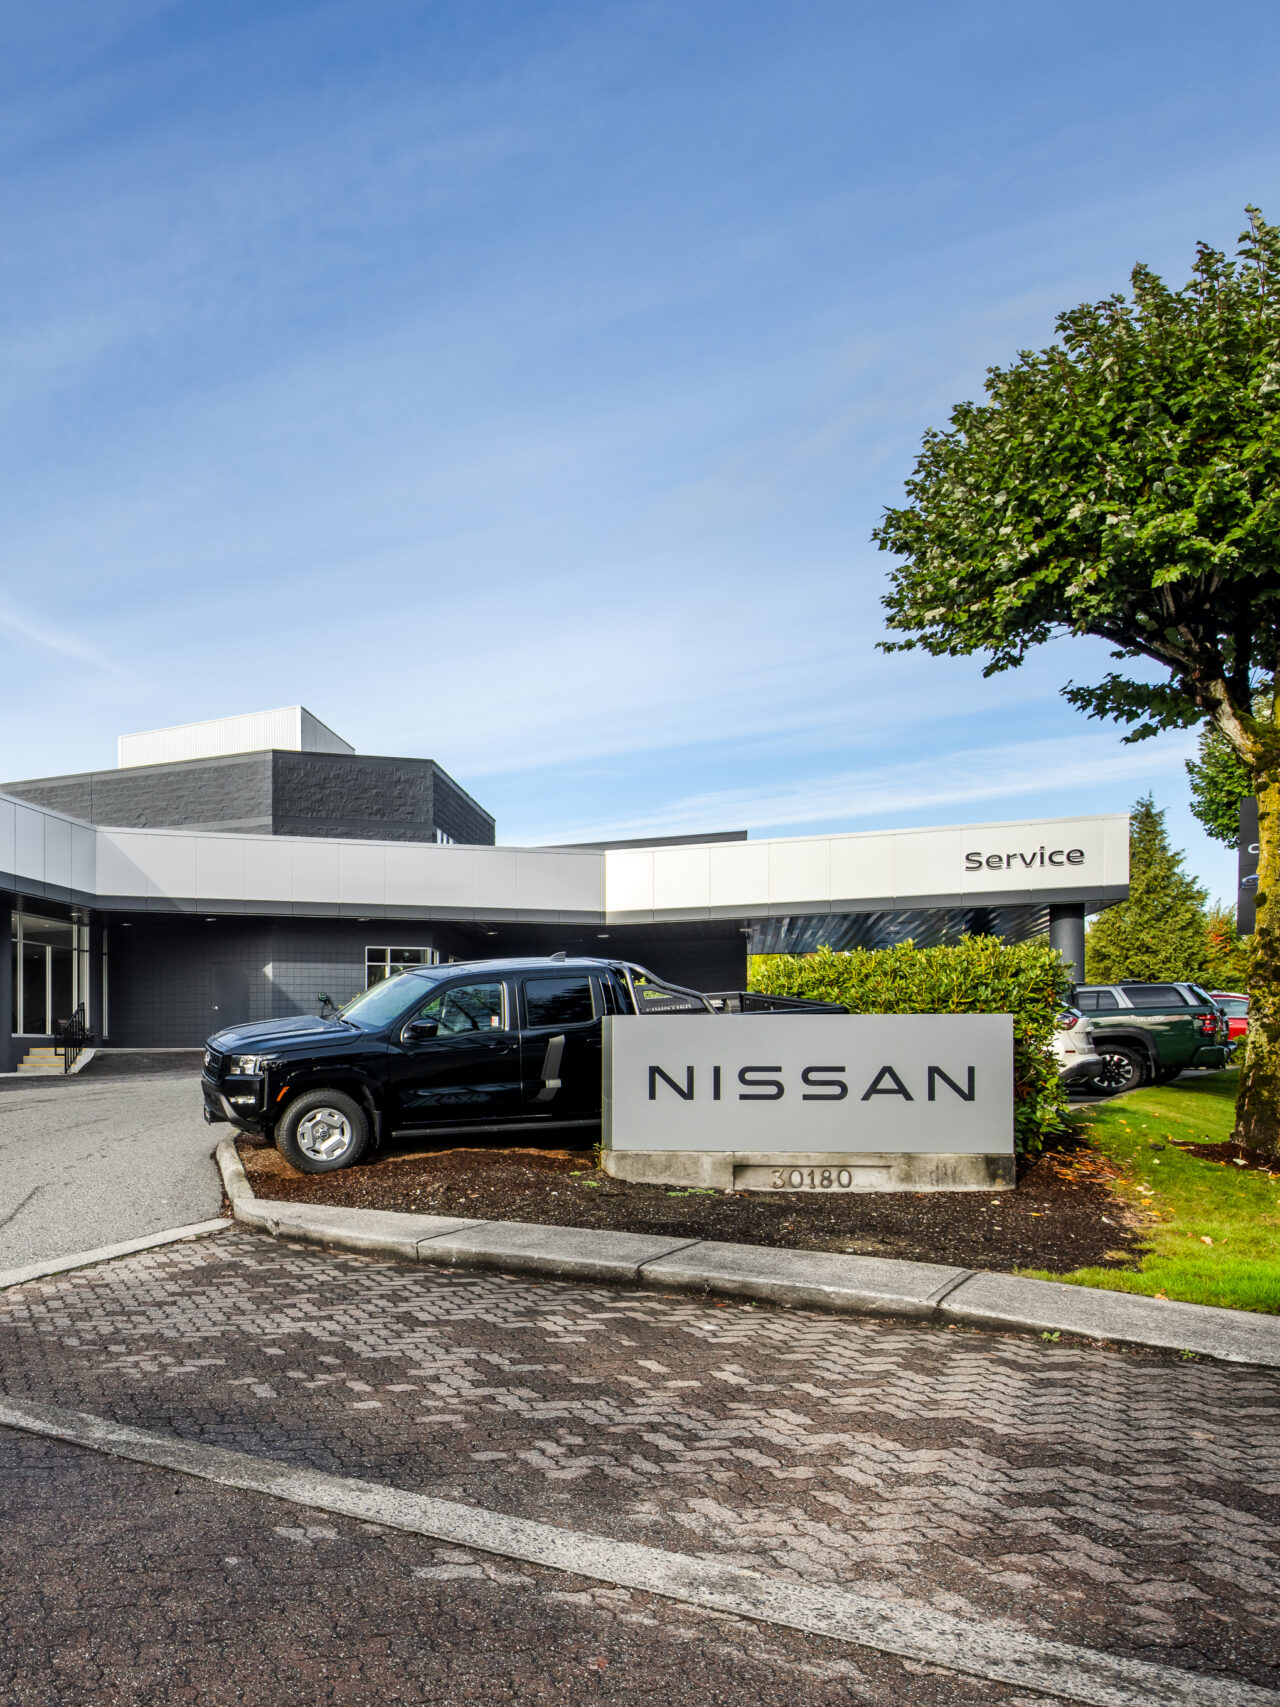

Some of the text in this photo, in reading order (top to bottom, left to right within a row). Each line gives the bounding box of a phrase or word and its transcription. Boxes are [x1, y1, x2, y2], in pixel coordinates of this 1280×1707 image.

[964, 845, 1086, 871] Service
[648, 1065, 976, 1101] NISSAN
[771, 1169, 853, 1189] 30180
